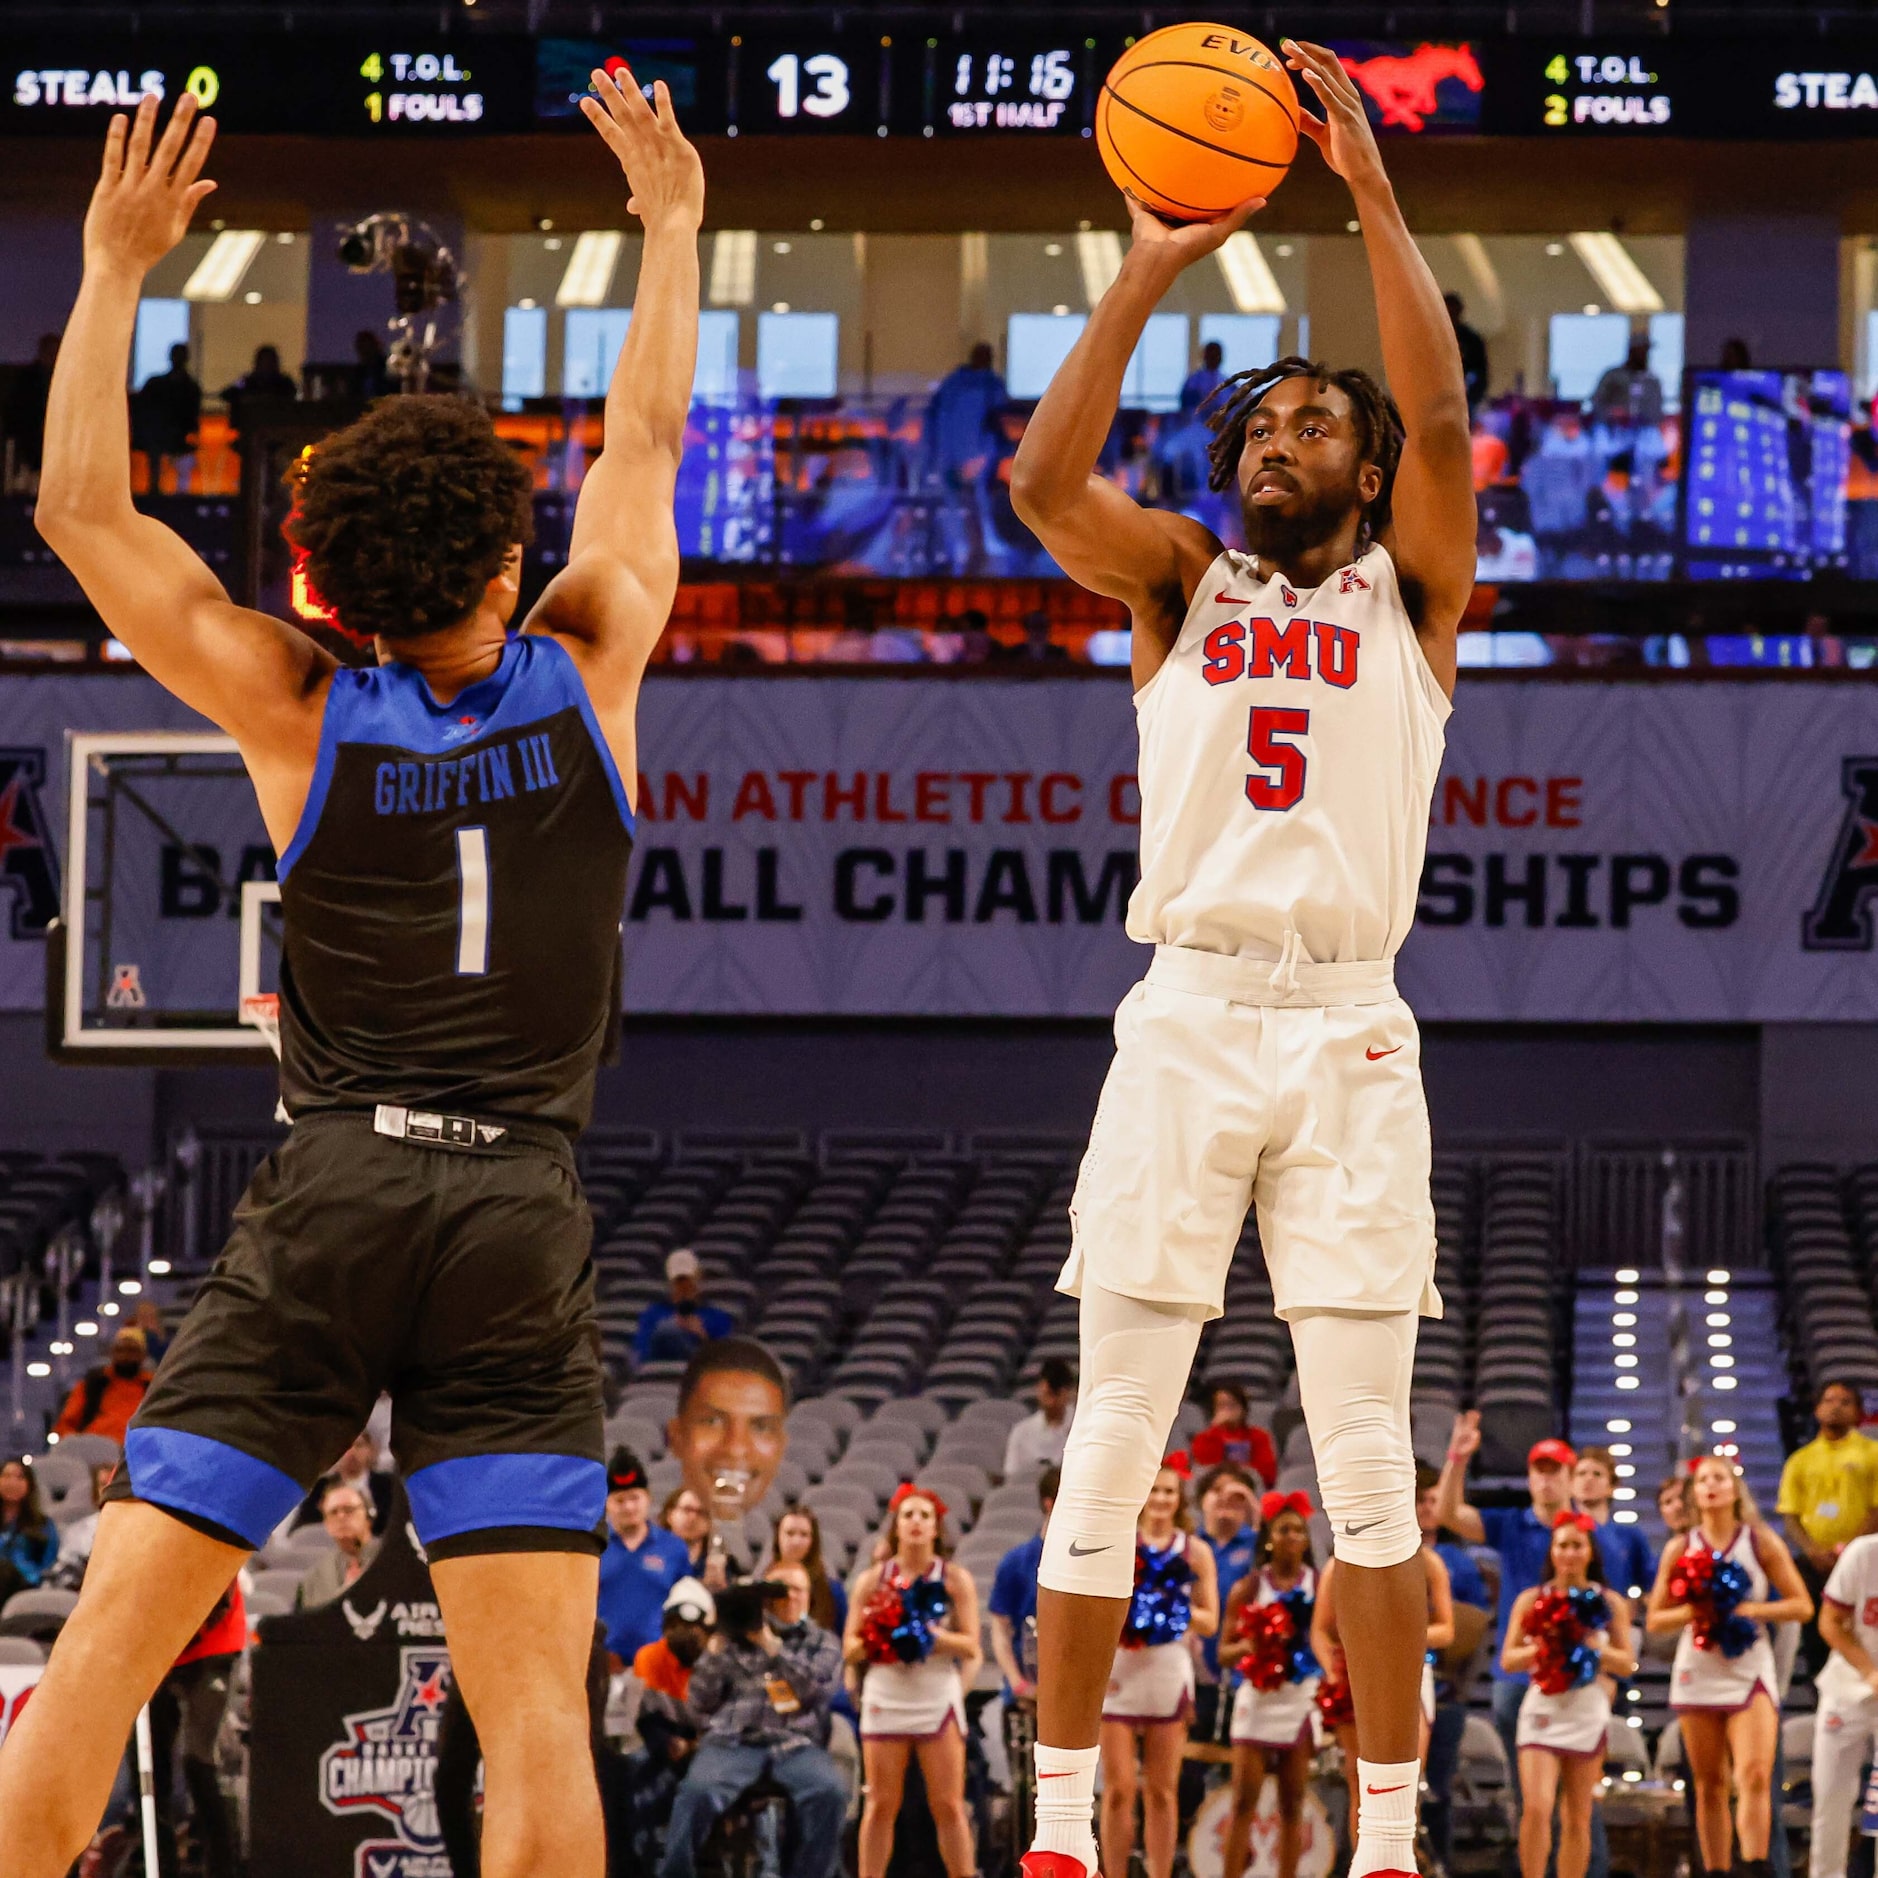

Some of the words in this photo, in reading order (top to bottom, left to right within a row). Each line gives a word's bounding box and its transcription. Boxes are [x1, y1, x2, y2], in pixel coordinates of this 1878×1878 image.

[13, 69, 165, 106] STEALS
[185, 65, 219, 110] 0
[360, 52, 384, 83] 4
[389, 53, 471, 81] T.O.L.
[767, 53, 850, 117] 13
[955, 50, 1074, 100] 11:16
[1545, 54, 1570, 85] 4
[1574, 55, 1658, 84] T.O.L.
[1774, 71, 1878, 109] STEA
[364, 91, 382, 123] 1
[388, 93, 483, 121] FOULS
[1544, 94, 1568, 126] 2
[1574, 95, 1670, 123] FOULS
[1202, 616, 1360, 690] SMU
[374, 743, 515, 816] GRIFFIN
[516, 732, 560, 792] III
[1245, 706, 1310, 812] 5
[731, 771, 1083, 825] ATHLETIC
[455, 824, 492, 977] 1
